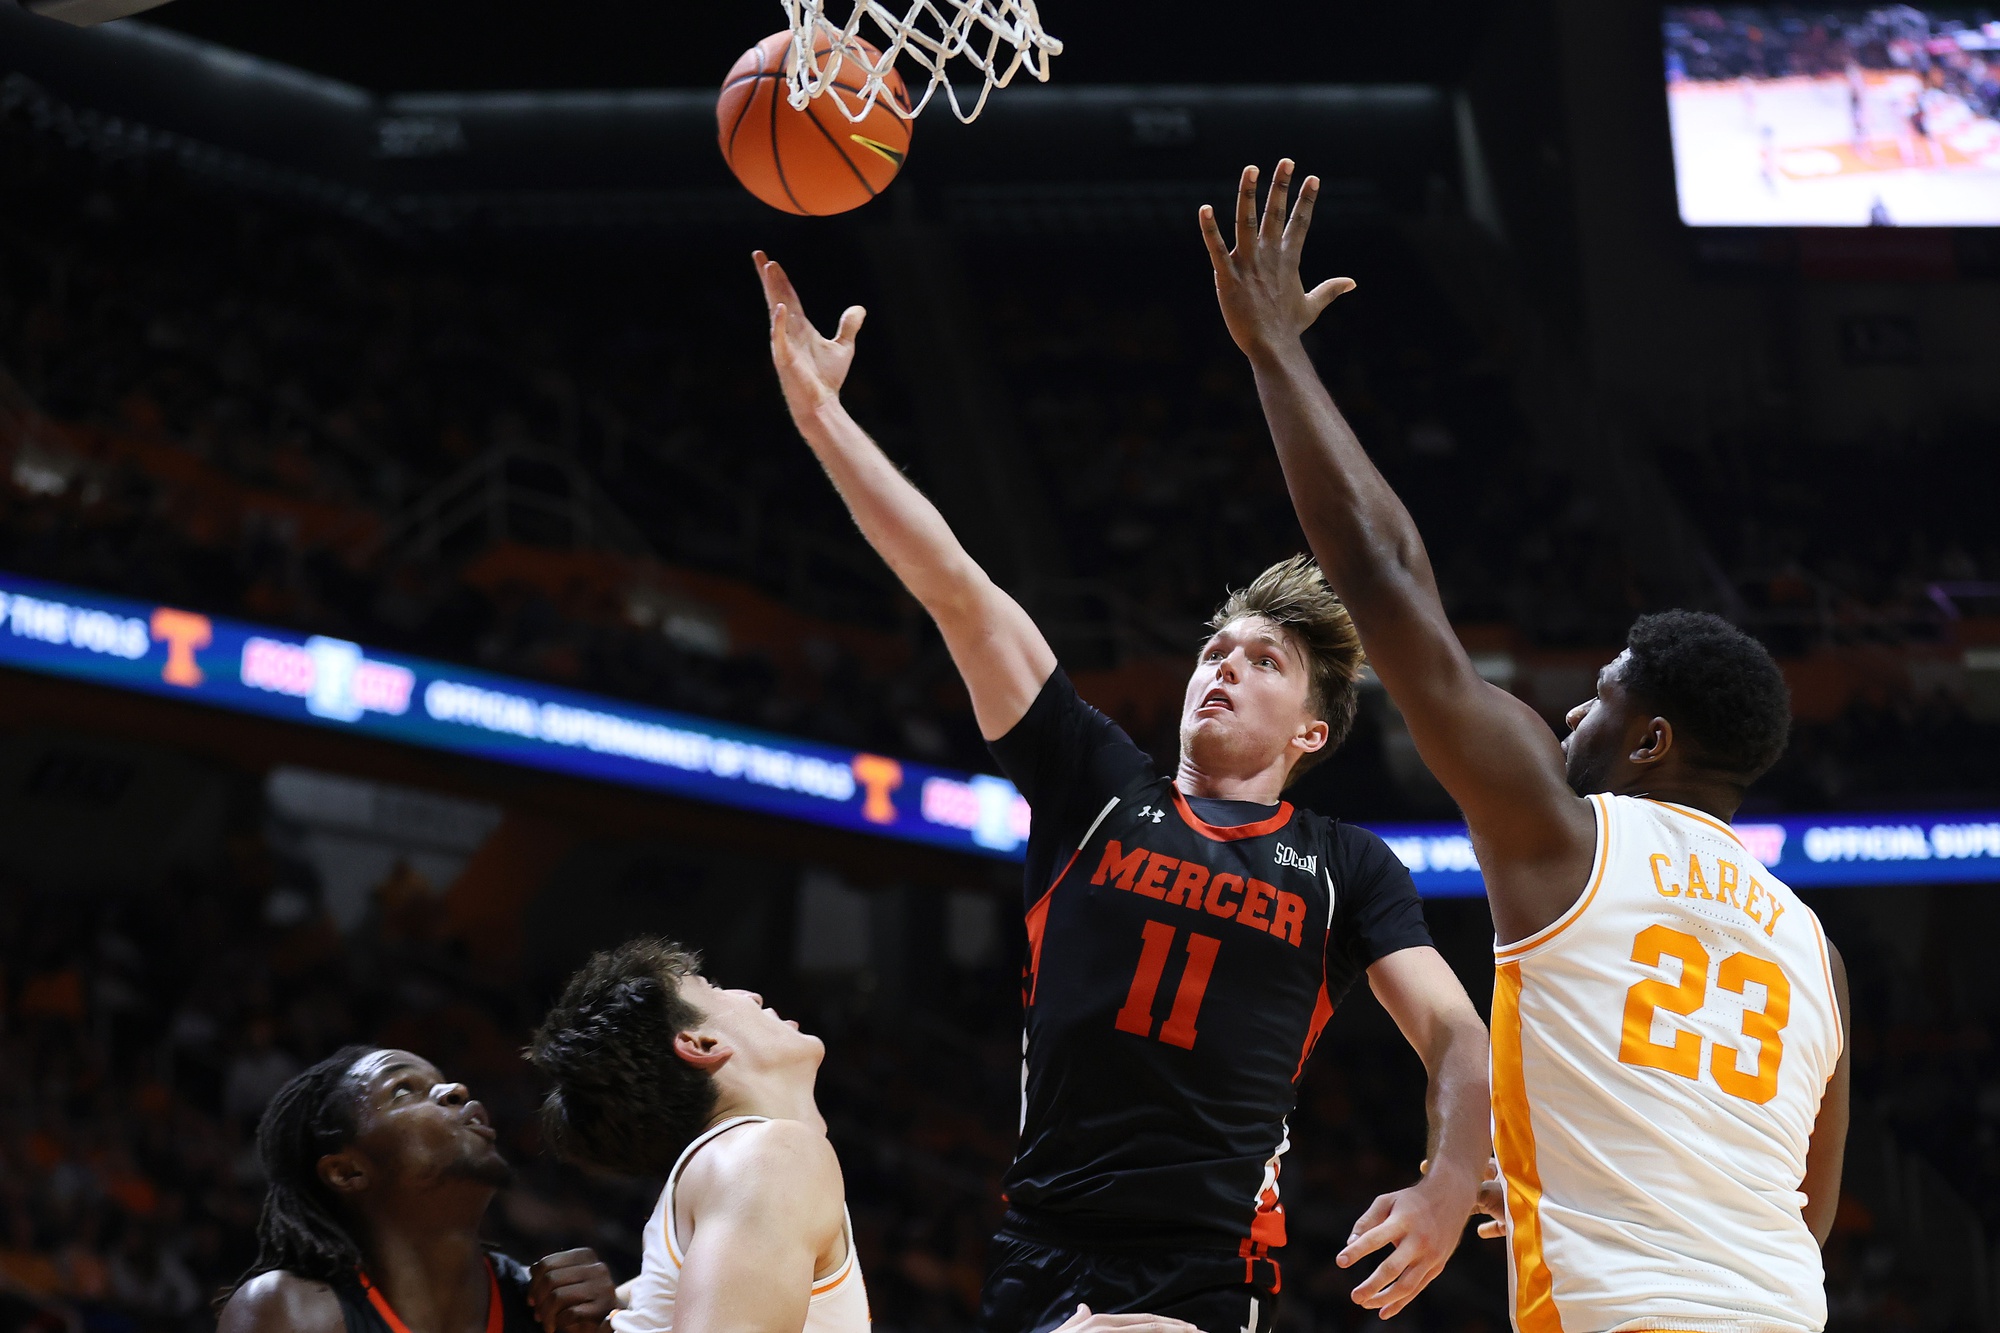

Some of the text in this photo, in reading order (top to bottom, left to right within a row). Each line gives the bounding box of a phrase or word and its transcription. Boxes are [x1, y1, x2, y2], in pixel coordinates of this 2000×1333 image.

[151, 608, 211, 687] T
[425, 680, 538, 738] OFFICIAL
[853, 754, 901, 823] T
[1804, 826, 1932, 862] OFFICIAL
[1090, 839, 1307, 949] MERCER
[1649, 853, 1785, 937] CAREY
[1115, 919, 1222, 1051] 11
[1618, 923, 1791, 1106] 23
